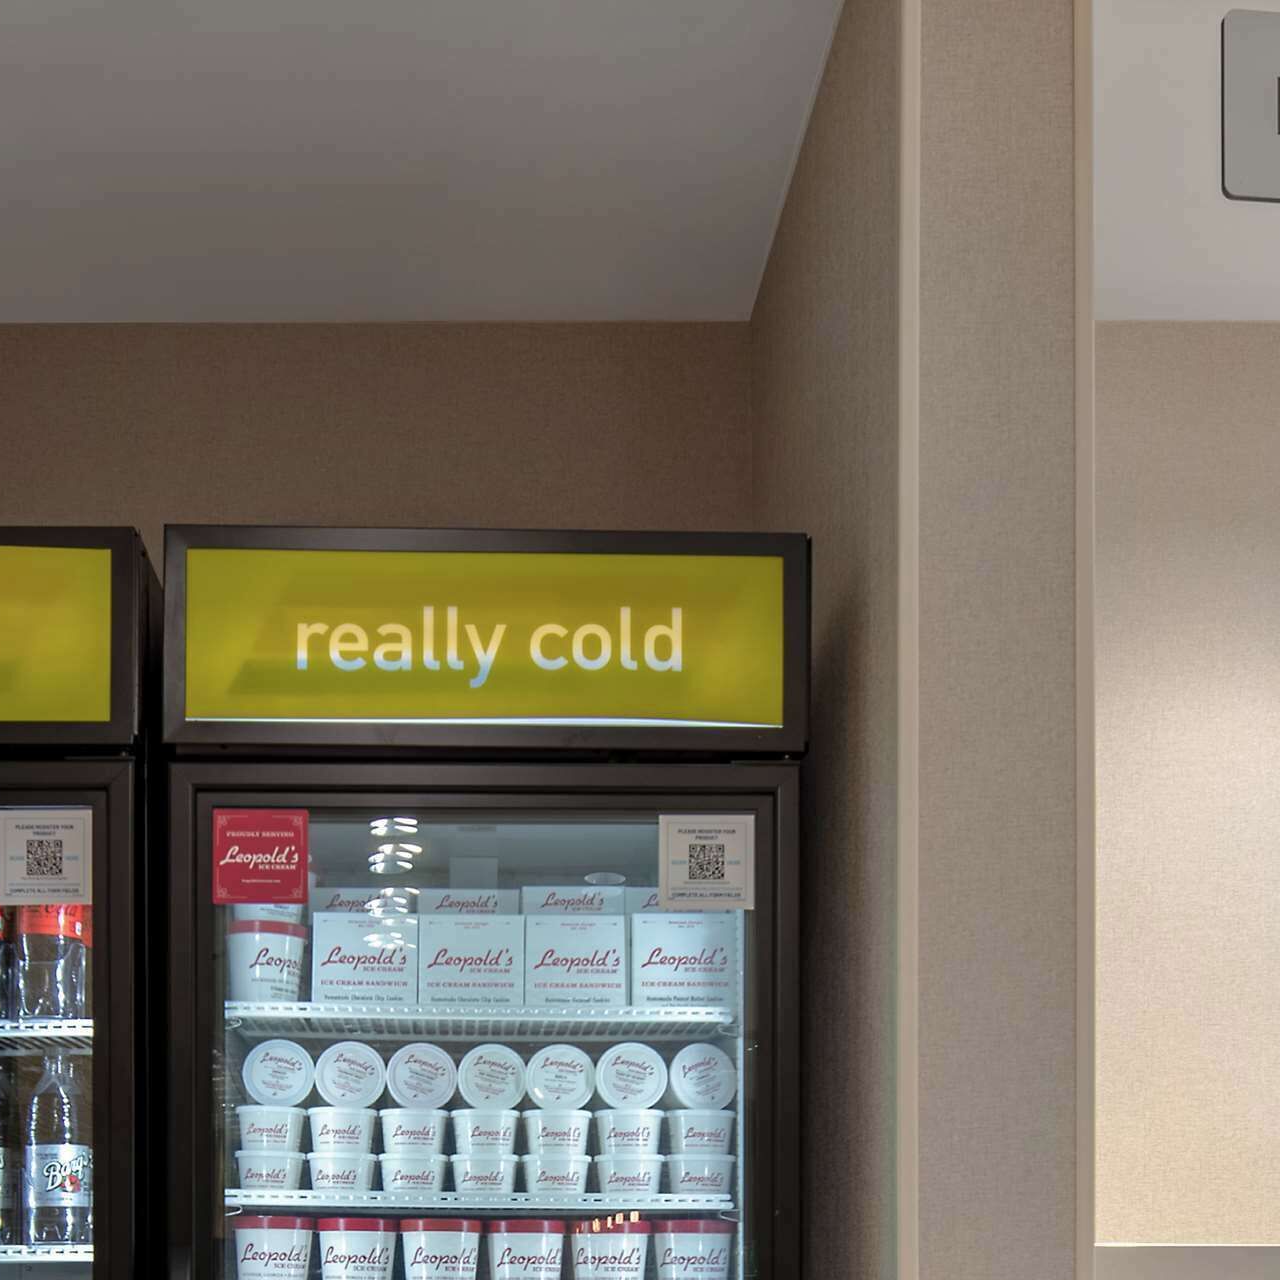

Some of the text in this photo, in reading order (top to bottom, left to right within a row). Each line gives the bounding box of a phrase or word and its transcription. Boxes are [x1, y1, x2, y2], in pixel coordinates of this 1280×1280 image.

[296, 606, 683, 688] really cold
[219, 845, 299, 869] Leopold's
[435, 894, 498, 912] Leopold's
[540, 891, 604, 910] Leopold's
[321, 946, 406, 970] Leopold's
[427, 948, 513, 972] Leopold's
[534, 949, 620, 973] Leopold's
[641, 947, 728, 972] Leopold's
[497, 1247, 561, 1271] Leopold'
[576, 1248, 641, 1271] Leopold's
